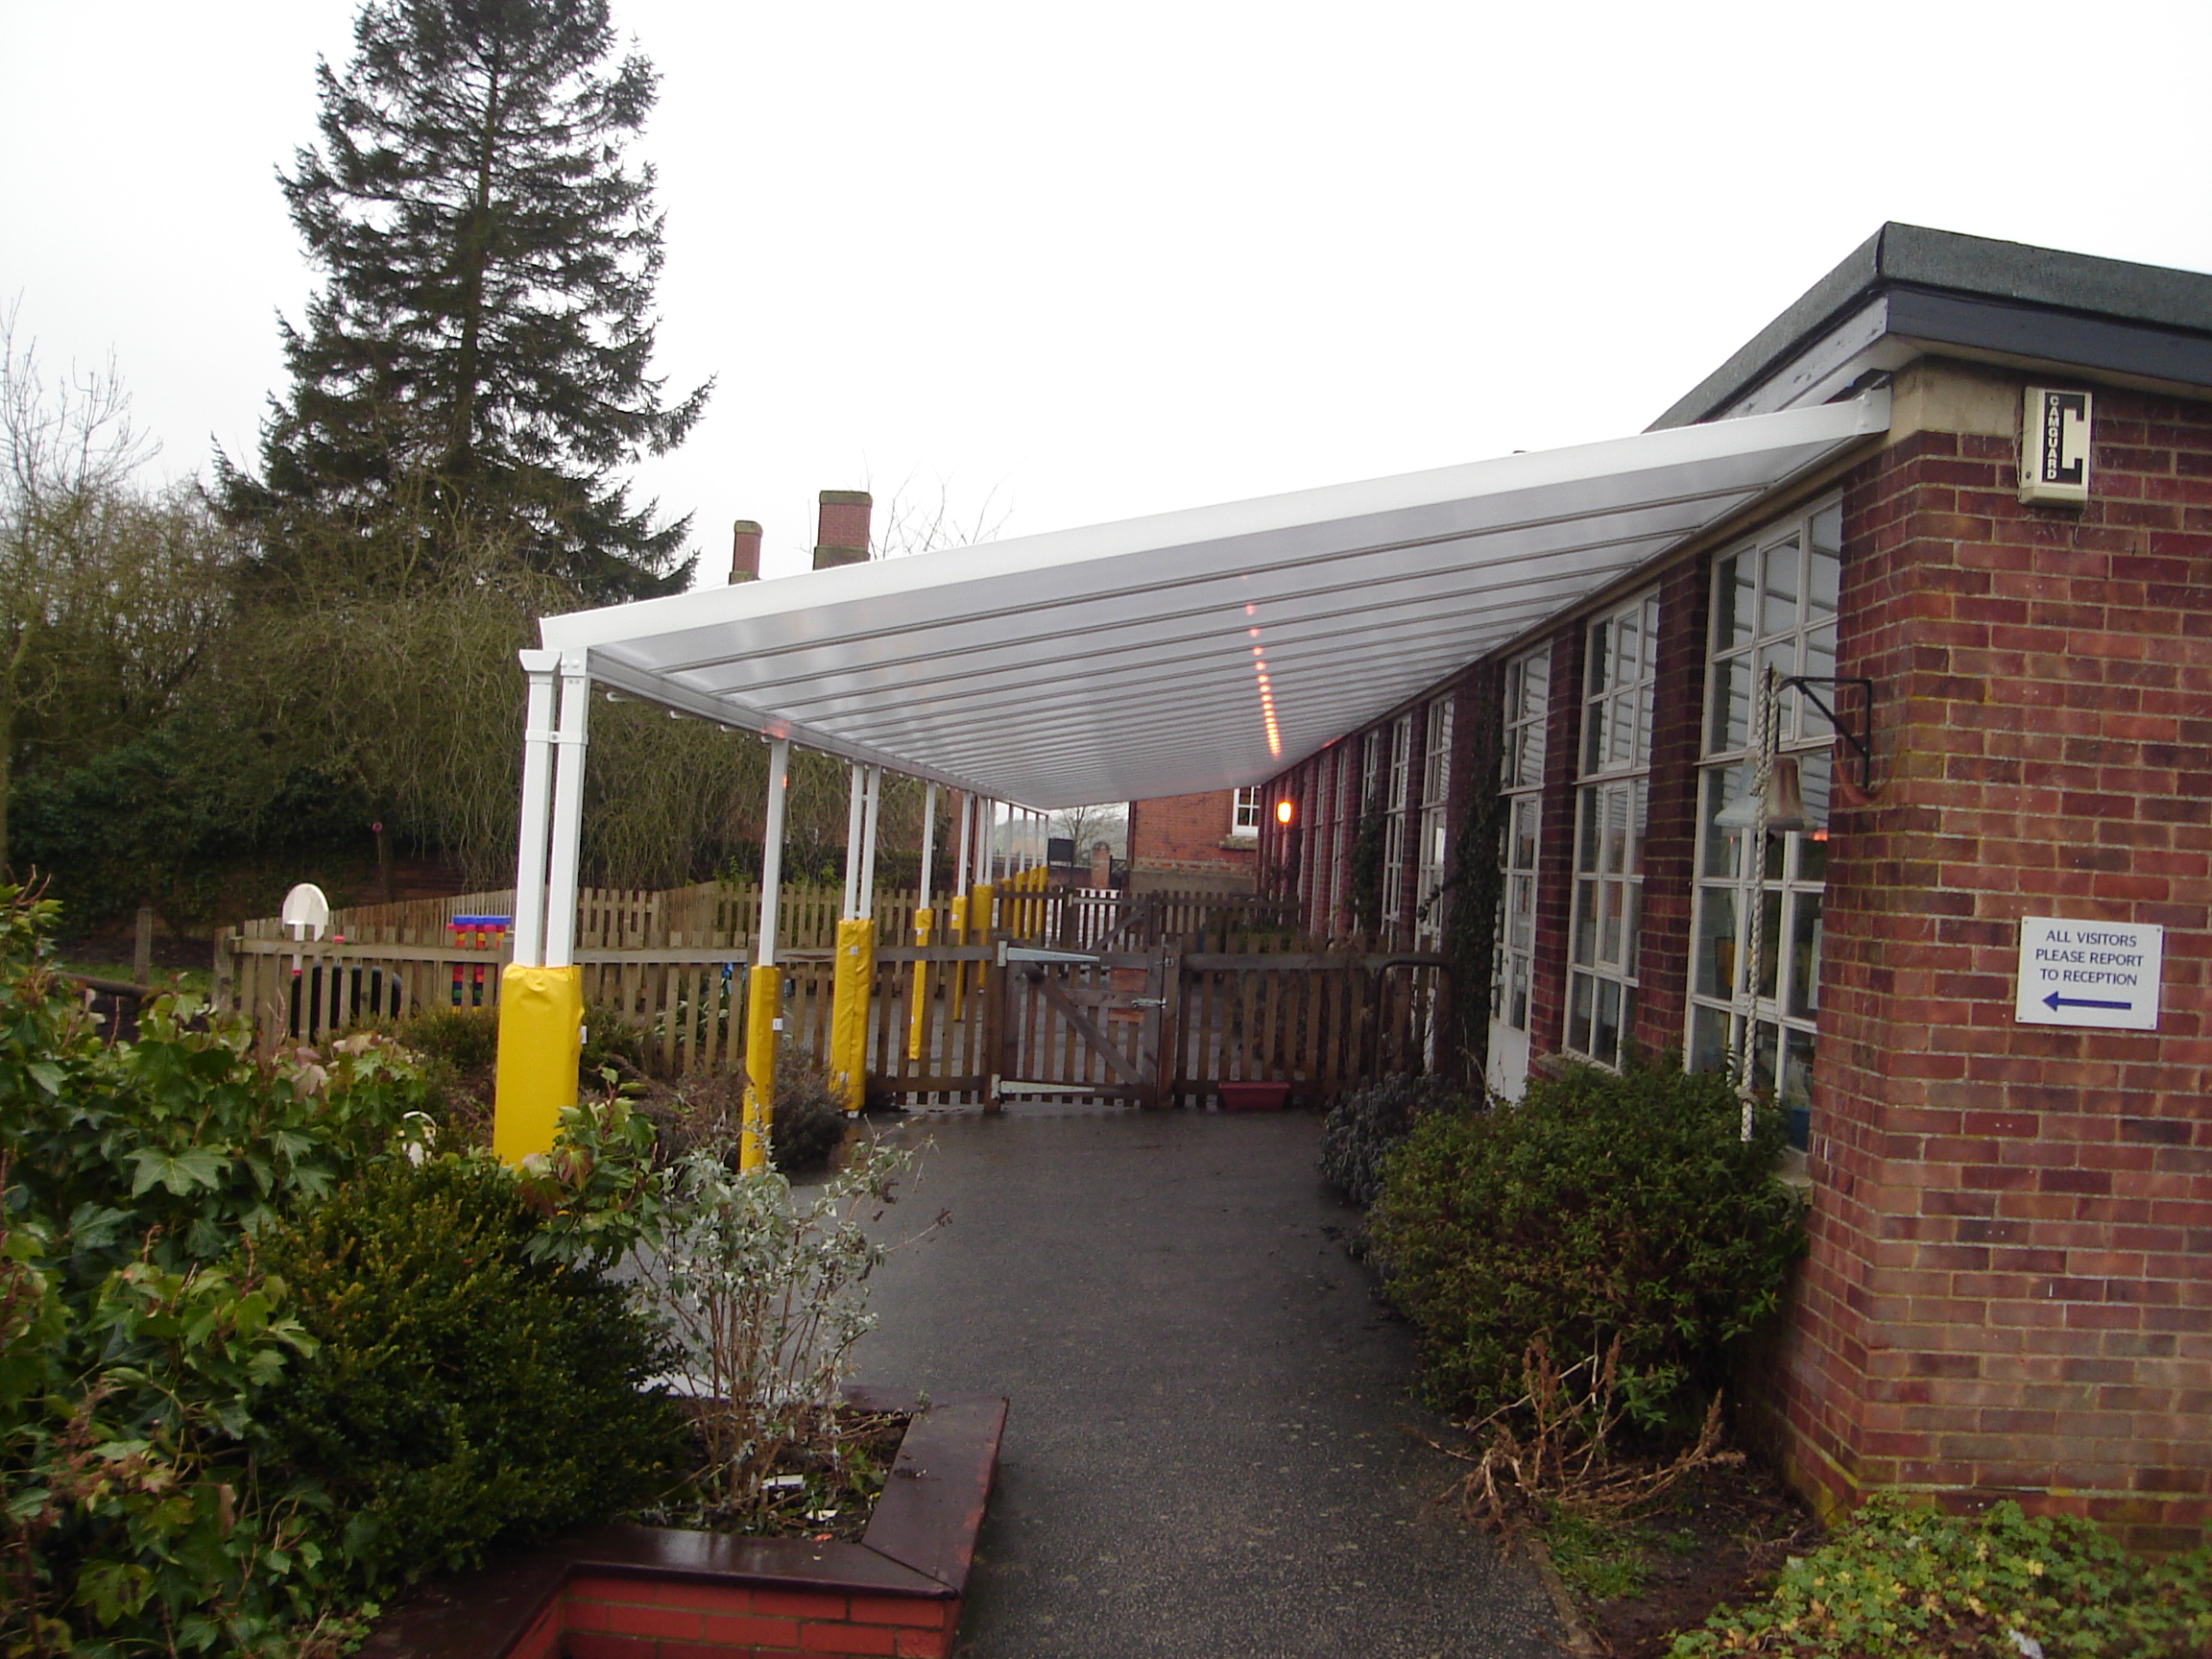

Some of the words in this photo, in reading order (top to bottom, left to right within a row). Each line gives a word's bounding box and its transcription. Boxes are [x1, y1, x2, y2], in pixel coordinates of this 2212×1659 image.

[2047, 396, 2059, 479] CAMGUARD
[2046, 929, 2072, 943] ALL
[2077, 931, 2137, 948] VISITORS
[2035, 949, 2085, 963] PLEASE
[2089, 952, 2144, 967] REPORT
[2040, 968, 2059, 981] TO
[2063, 970, 2138, 986] RECEPTION
